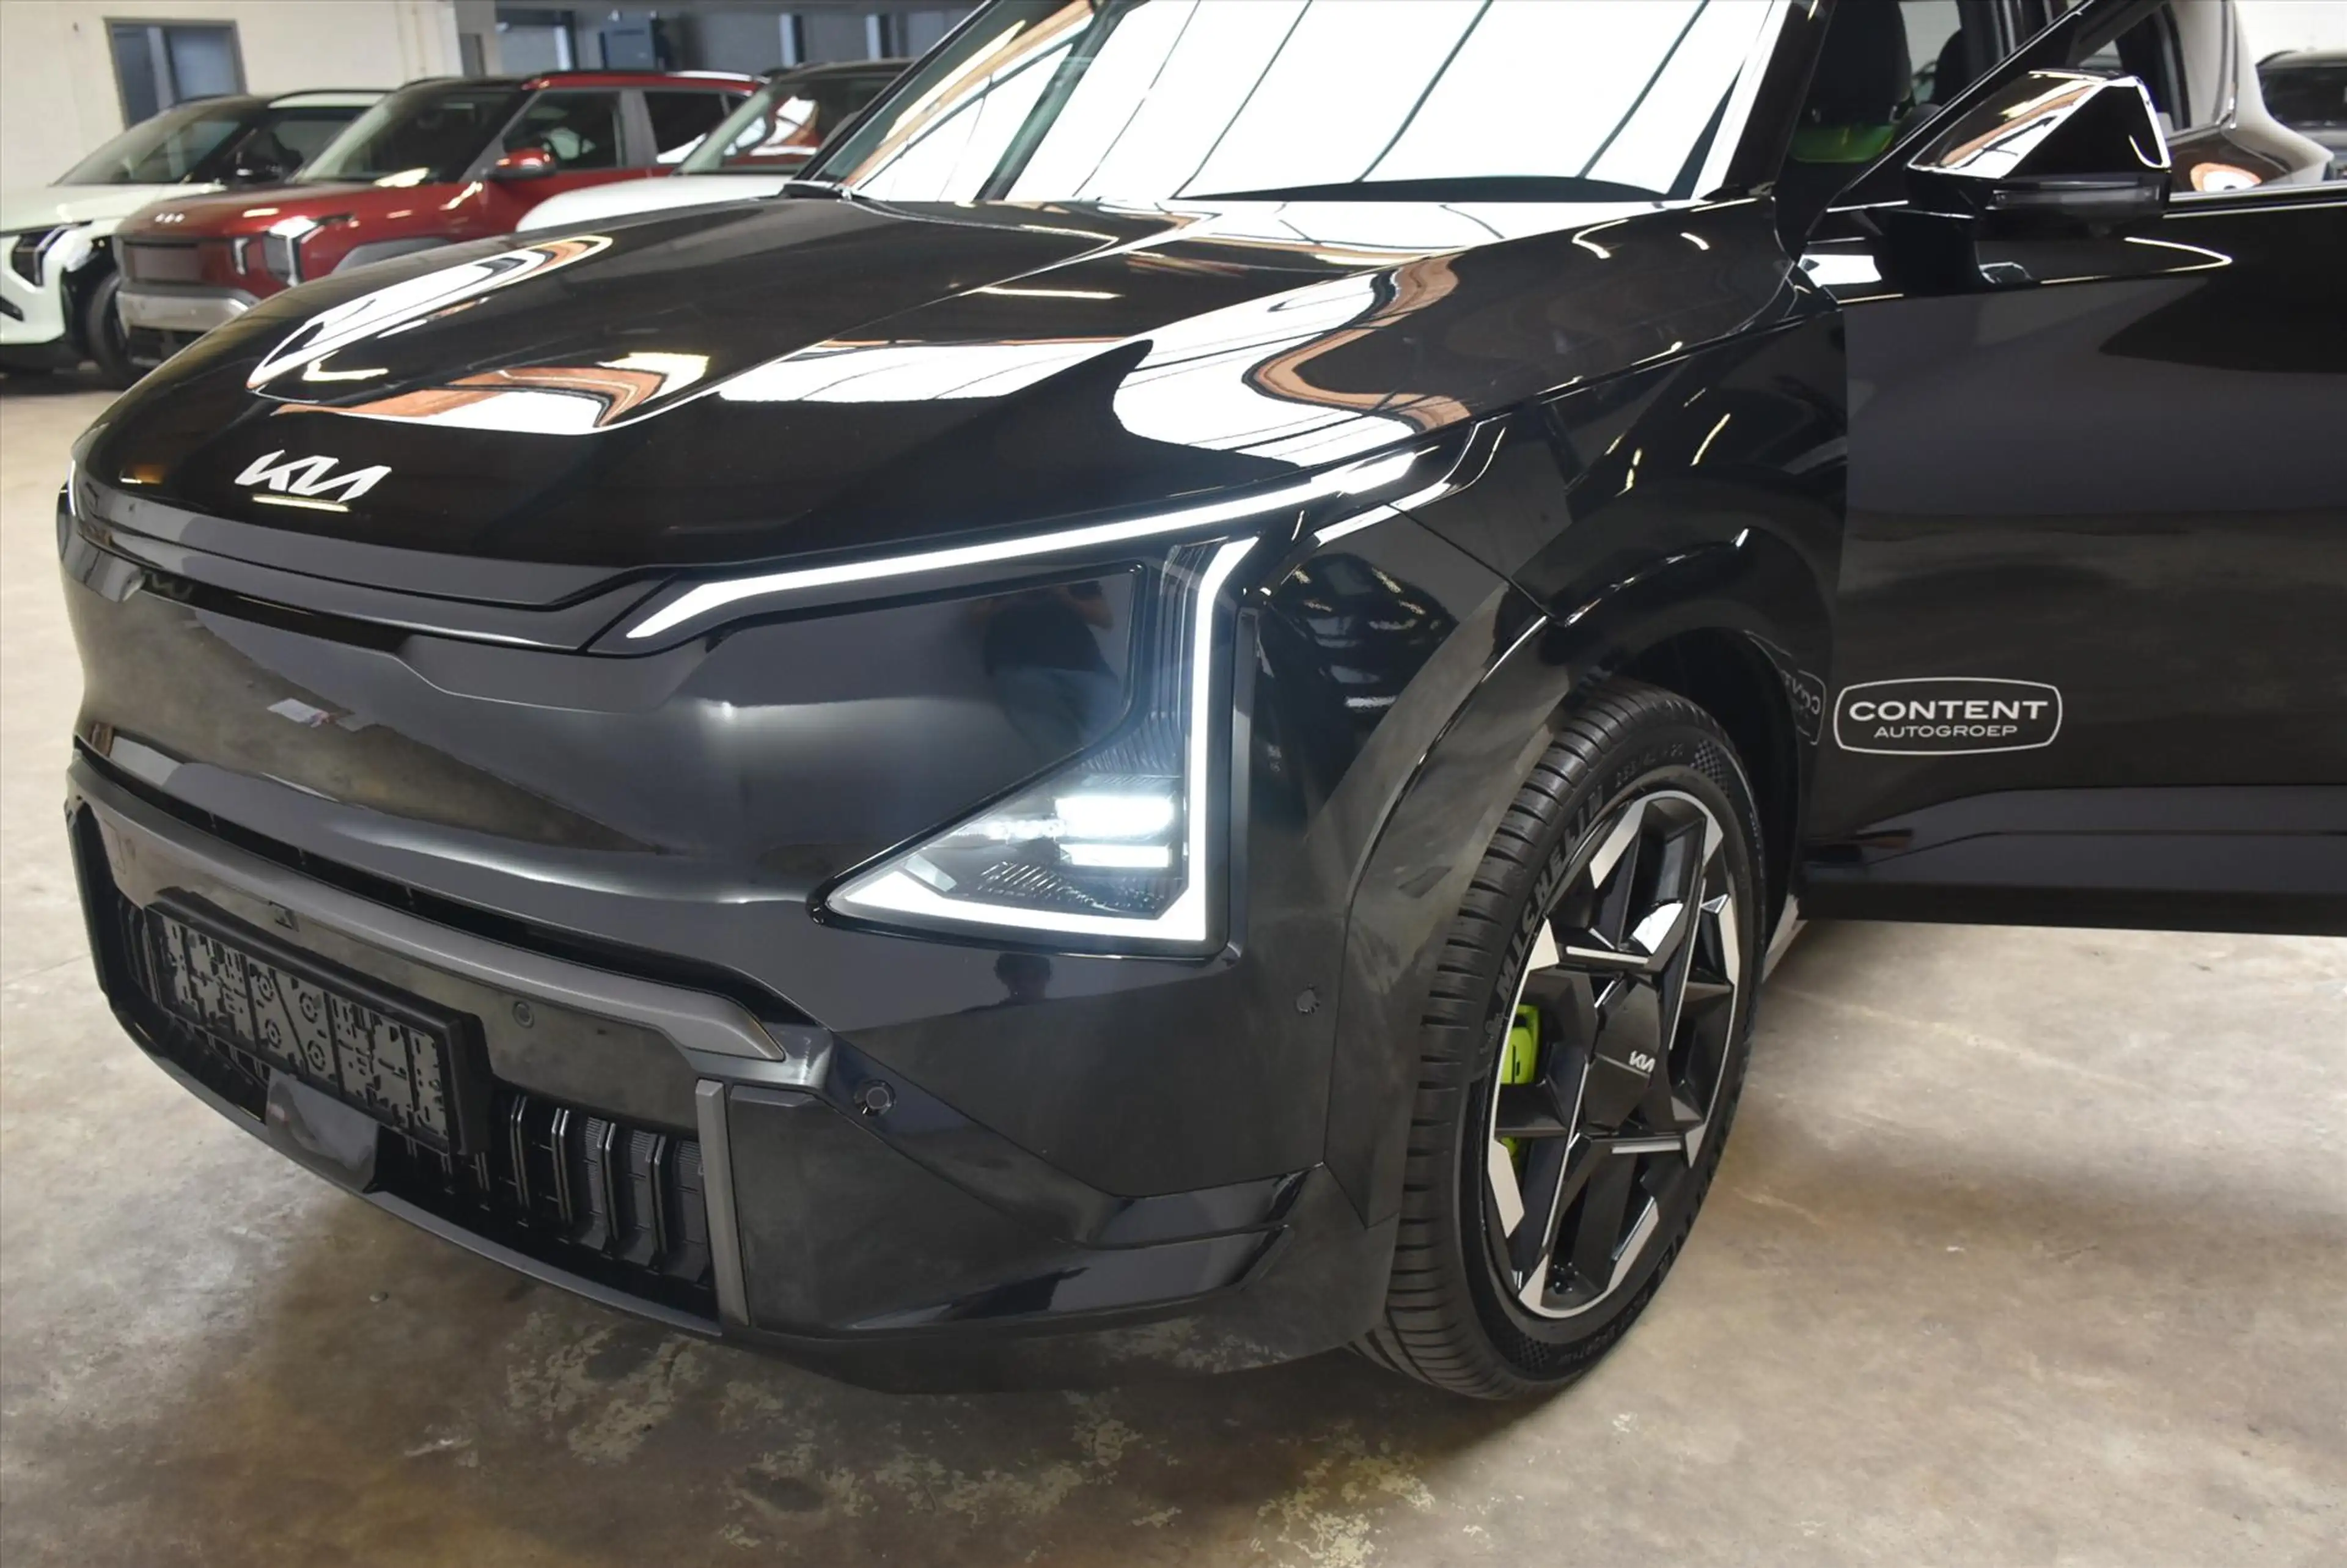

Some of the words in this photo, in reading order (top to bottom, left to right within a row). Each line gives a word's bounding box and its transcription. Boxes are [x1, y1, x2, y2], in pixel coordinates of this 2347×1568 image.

[235, 449, 392, 503] KIA
[1849, 701, 2048, 721] CONTENT
[1874, 725, 2018, 738] AUTOGROEP
[1496, 785, 1604, 1003] MICHELIN
[1629, 1050, 1656, 1072] KIA
